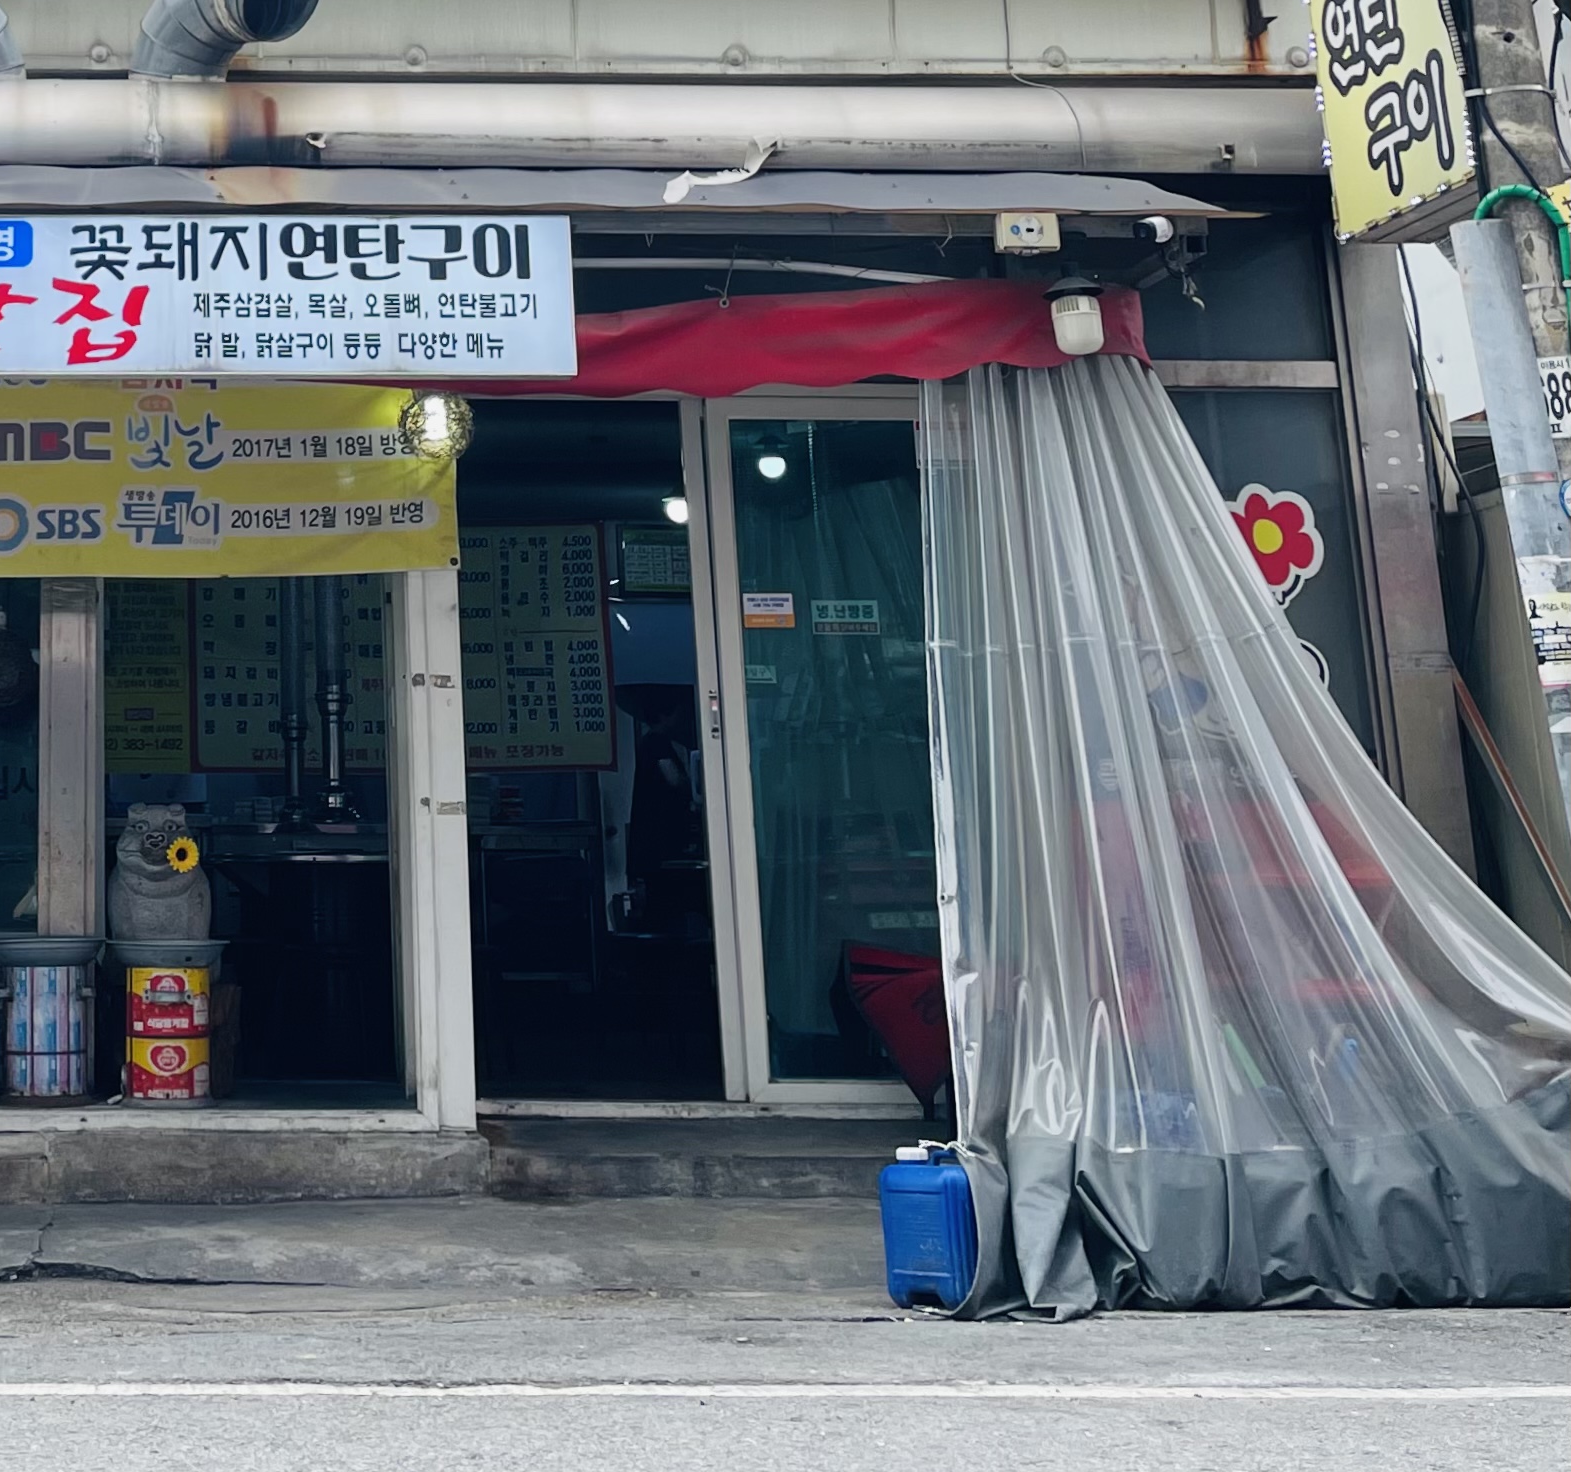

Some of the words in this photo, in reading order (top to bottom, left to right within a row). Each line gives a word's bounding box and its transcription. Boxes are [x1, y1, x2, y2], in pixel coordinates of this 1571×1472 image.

[1365, 48, 1454, 197] 구이
[192, 292, 300, 321] 제주삼겹살,
[308, 292, 354, 321] 목살,
[364, 292, 429, 321] 오돌뼈,
[437, 291, 539, 320] 연탄불고기
[255, 331, 336, 359] 닭살구이
[344, 332, 382, 360] 등등
[398, 331, 458, 360] 다양한
[466, 331, 505, 360] 메뉴
[232, 437, 292, 459] 2017년
[300, 436, 328, 458] 1월
[336, 435, 374, 456] 18일
[36, 509, 101, 540] SBS
[116, 500, 221, 544] 투데이
[230, 508, 292, 530] 2016년
[299, 506, 338, 529] 12월
[344, 504, 382, 526] 19일
